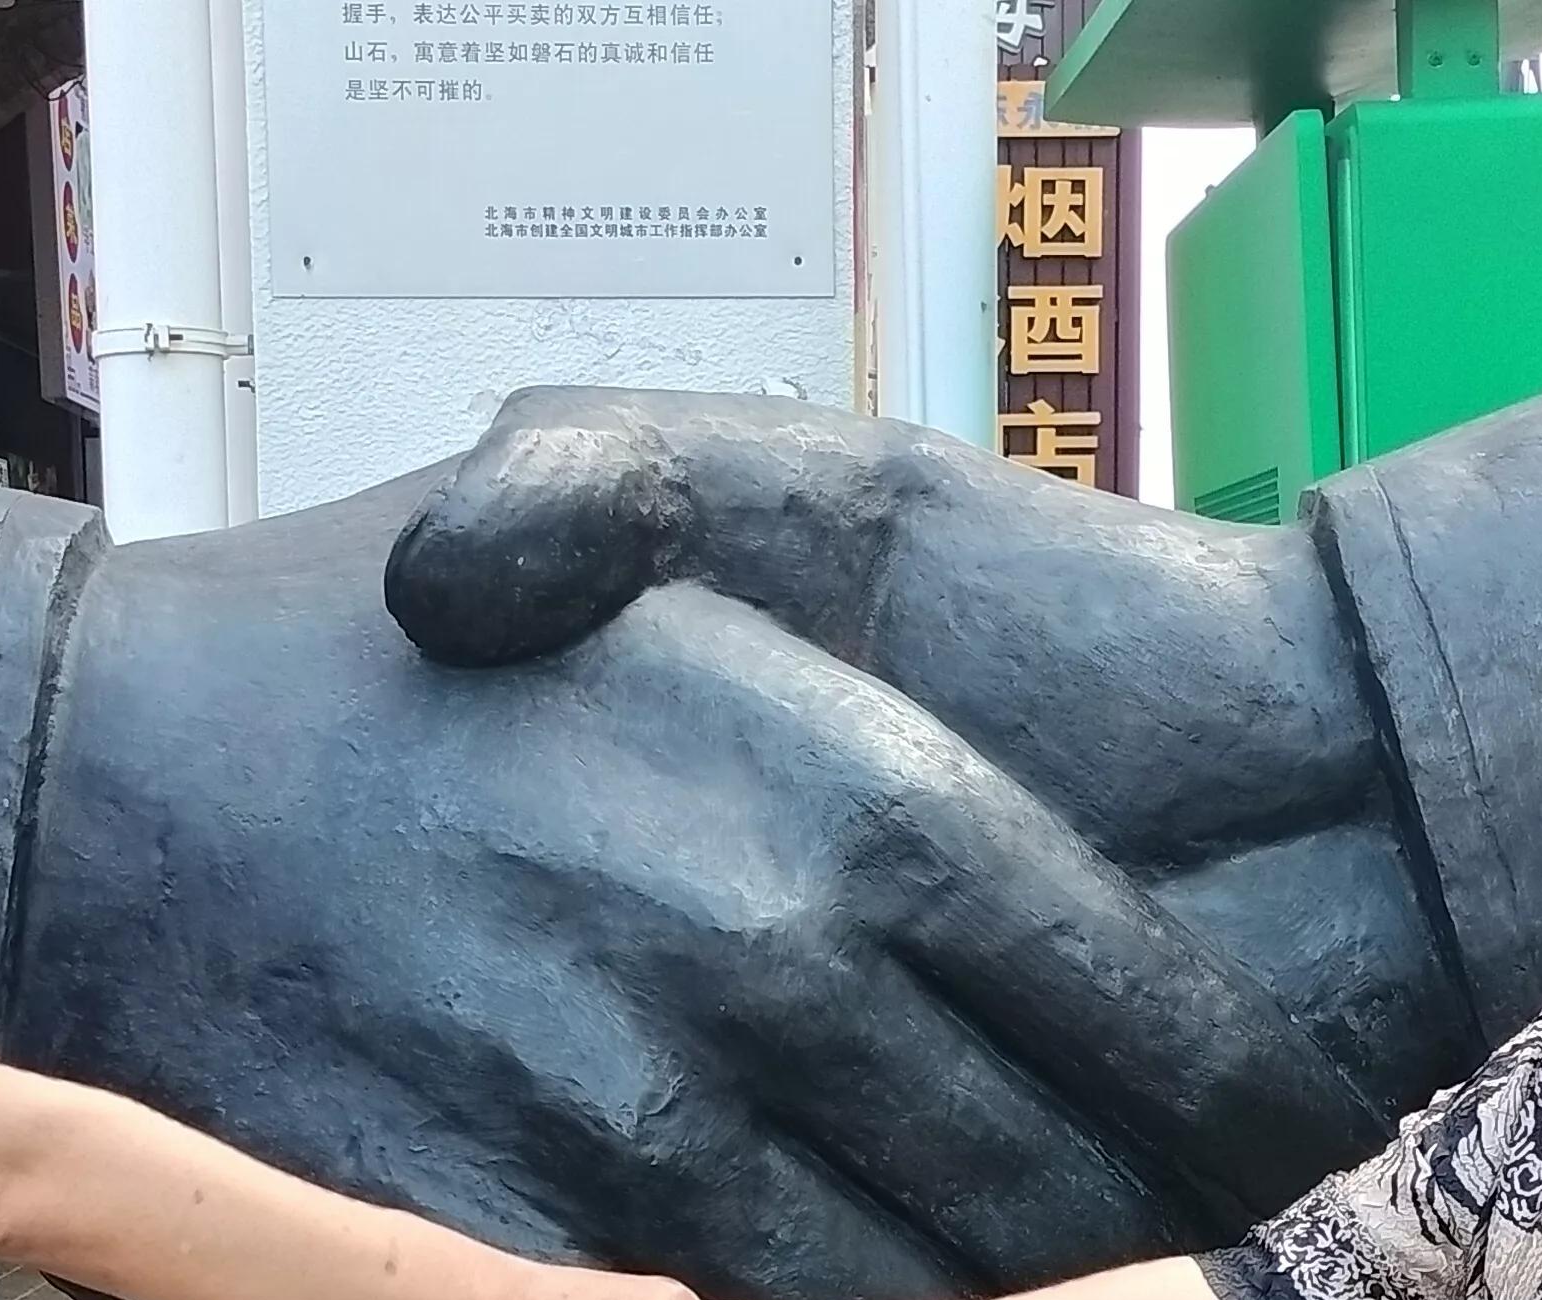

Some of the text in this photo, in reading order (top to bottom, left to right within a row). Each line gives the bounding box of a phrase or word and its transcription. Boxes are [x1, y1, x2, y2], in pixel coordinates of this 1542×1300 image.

[344, 41, 715, 64] 山石，寓意着坚如磐石的真诚和信任
[484, 206, 769, 221] 北海市精神文明建设委员会办公室
[484, 223, 769, 239] 北海市创建全国文明城市工作指挥部办公室
